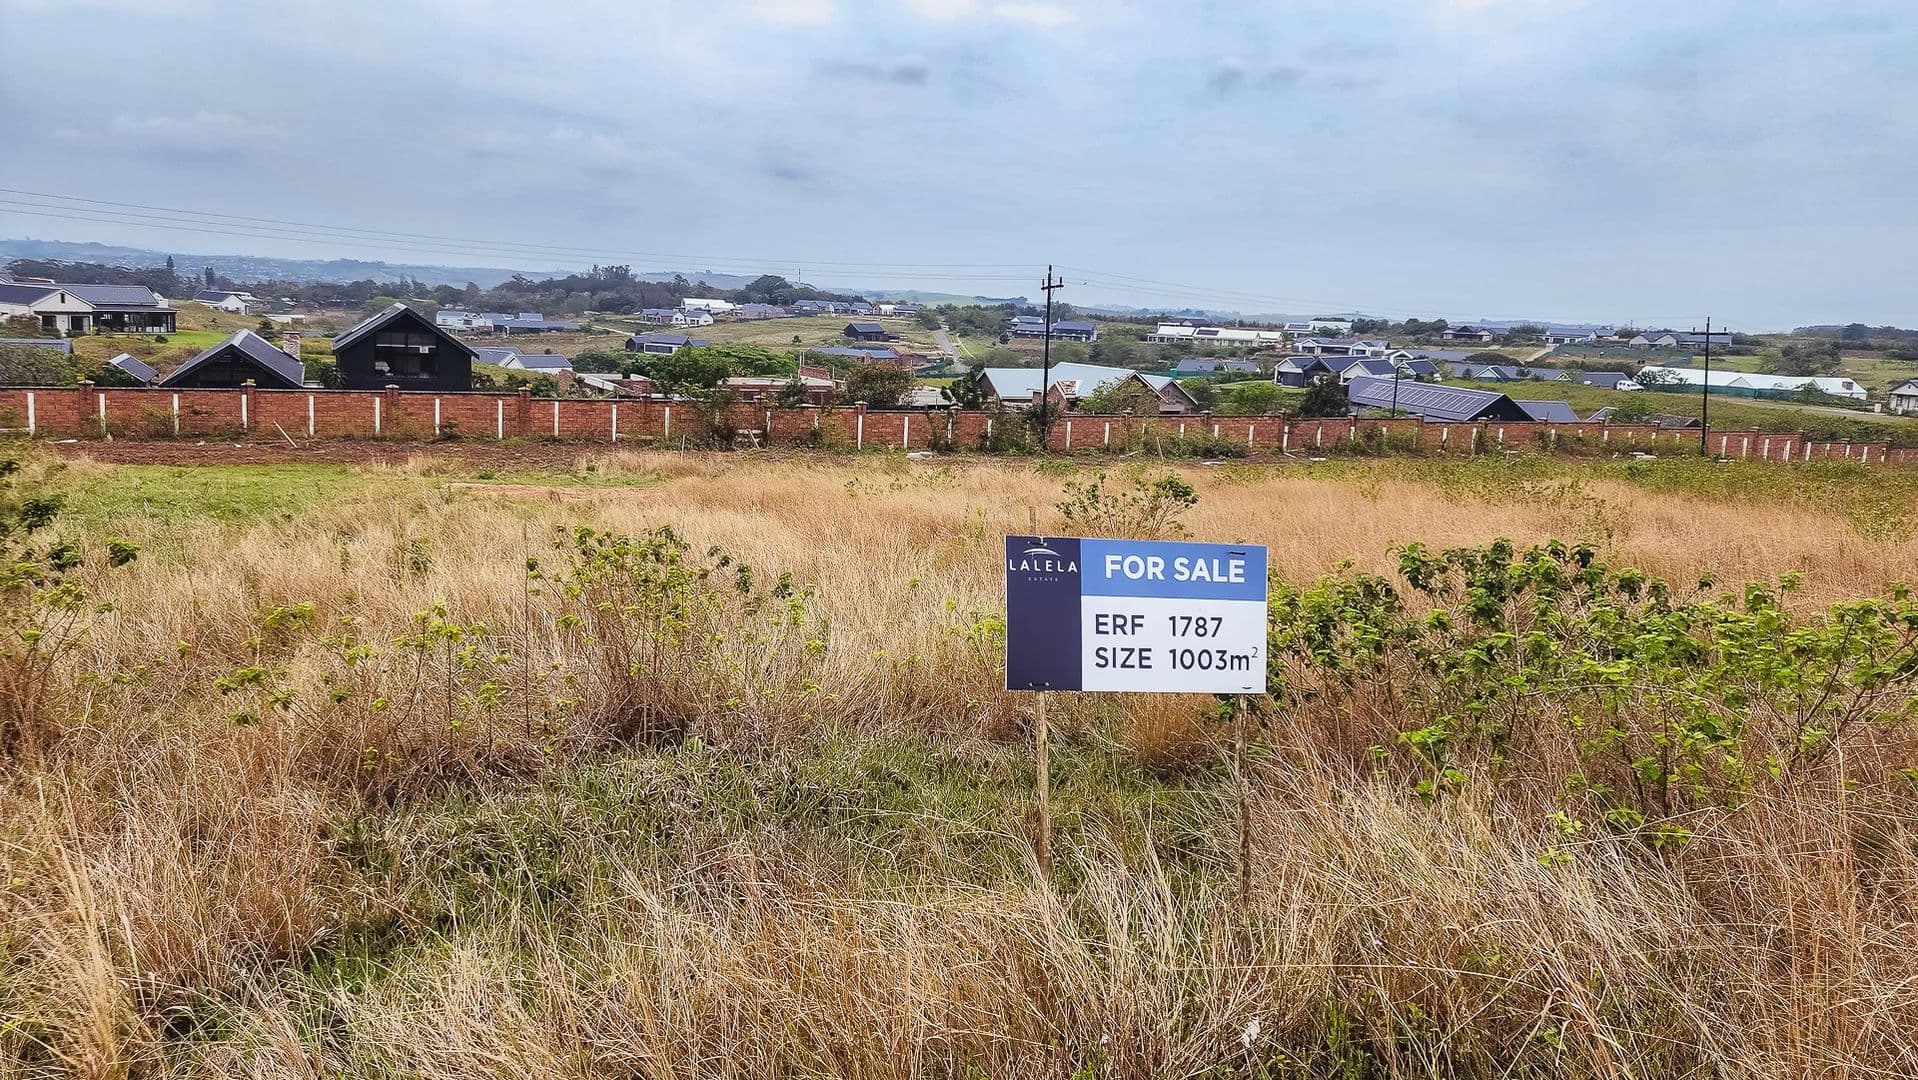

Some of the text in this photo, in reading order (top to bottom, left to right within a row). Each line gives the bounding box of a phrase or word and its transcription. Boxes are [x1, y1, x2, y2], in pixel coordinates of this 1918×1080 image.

[1009, 559, 1078, 573] LALELA
[1105, 555, 1246, 583] FOR SALE
[1095, 614, 1223, 638] ERF 1787
[1095, 647, 1153, 669] SIZE
